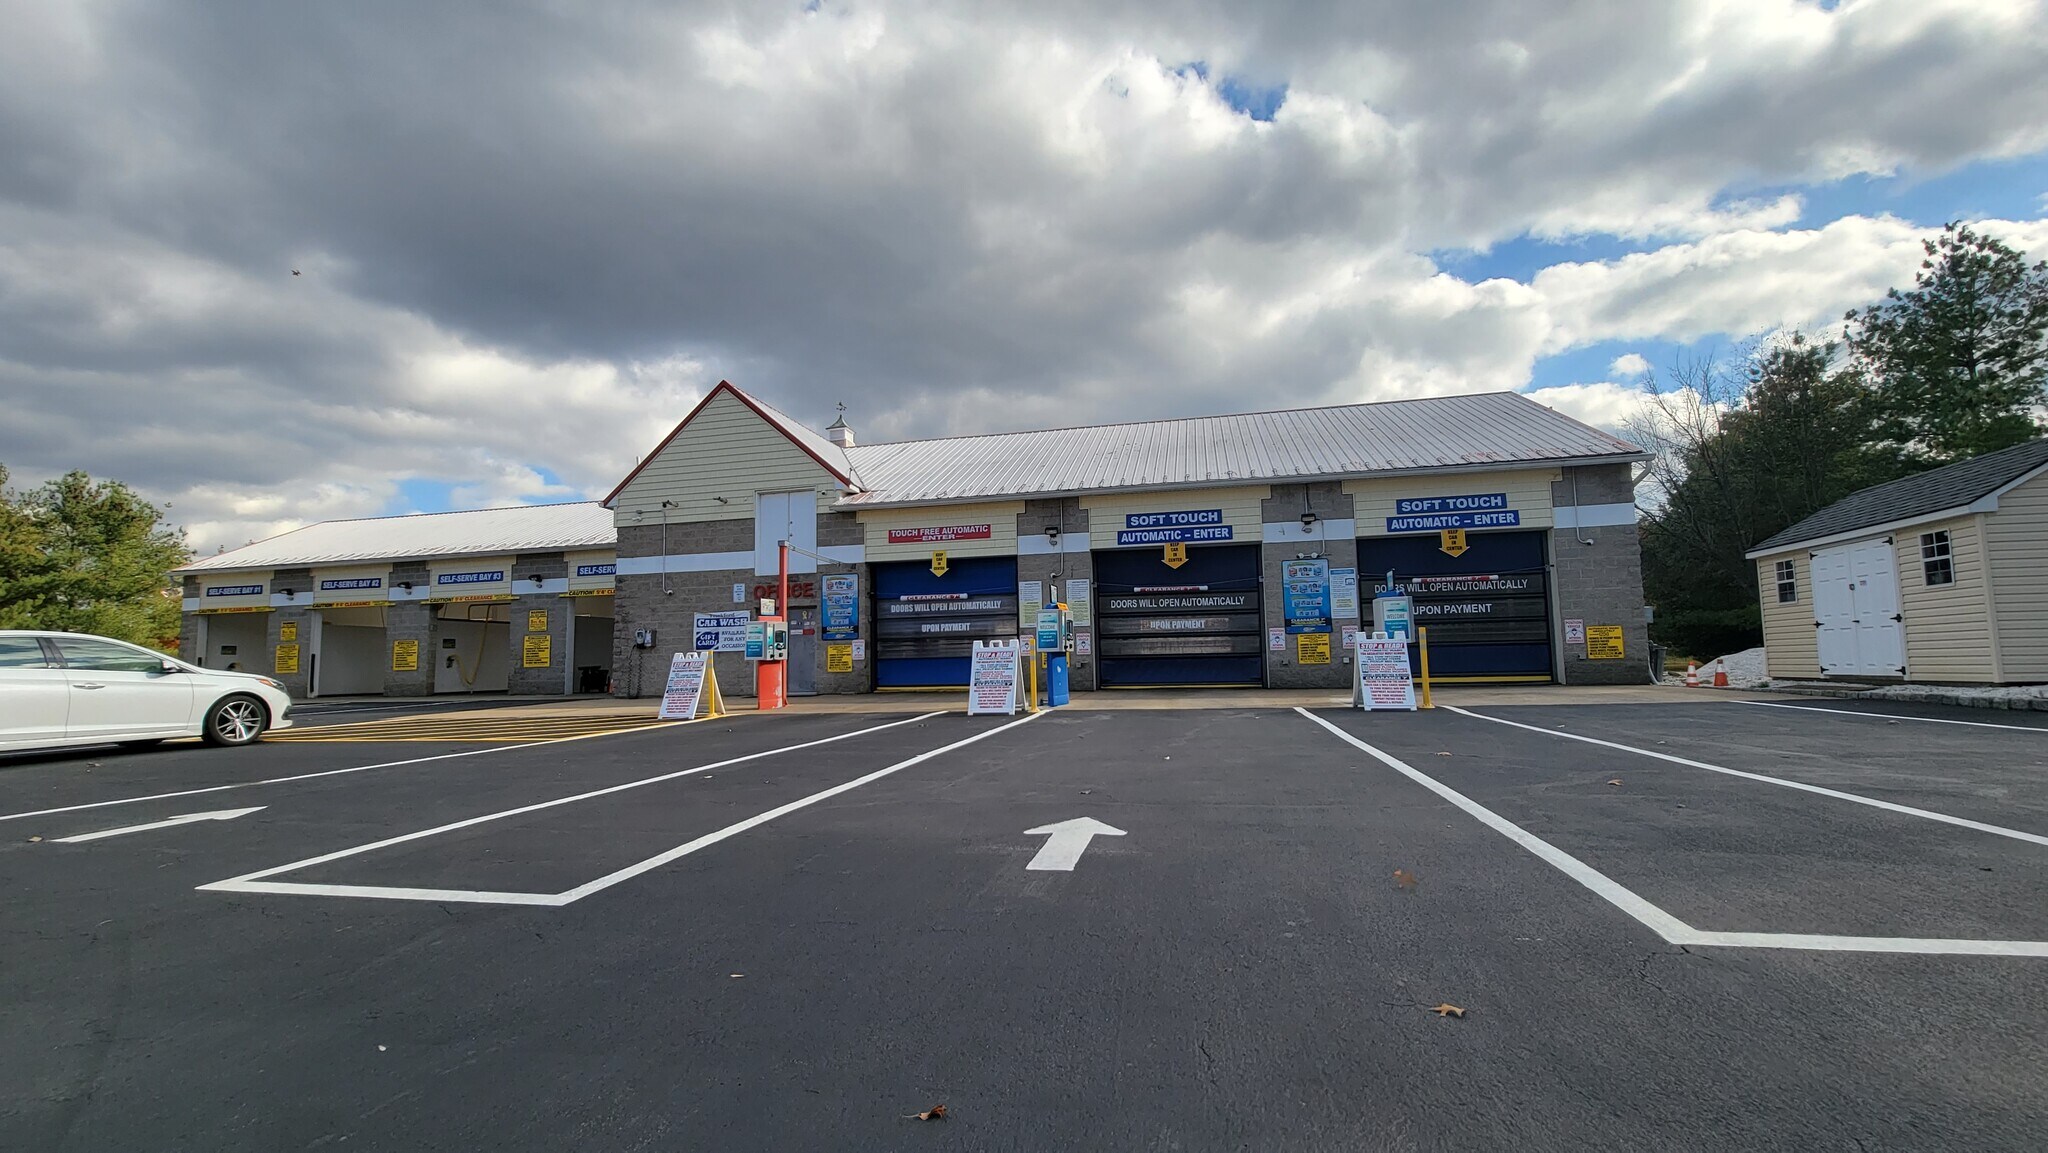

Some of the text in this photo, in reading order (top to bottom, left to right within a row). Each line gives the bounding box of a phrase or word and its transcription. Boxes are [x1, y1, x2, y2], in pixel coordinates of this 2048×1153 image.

[1402, 496, 1501, 511] SOFT TOUCH
[1131, 512, 1218, 526] SOFT TOUCH
[1391, 516, 1460, 529] AUTOMATIC
[1474, 513, 1515, 524] ENTER
[942, 525, 988, 534] AUTOMATIC
[1121, 531, 1181, 542] AUTOMATIC
[1194, 528, 1229, 539] ENTER
[580, 565, 616, 574] SELF-SERV
[440, 572, 501, 583] SELF-SERVE BAY #3
[323, 579, 380, 589] SELF-SERVE BAY #2
[1374, 579, 1528, 593] DORS WILL OPEN AUTOMATICALLY
[208, 587, 242, 596] SELF-SERVE
[253, 586, 261, 594] #1
[891, 600, 1001, 613] DOORS WILL OPEN AUTOMATICALLY
[1111, 596, 1244, 608] DOORS WILL OPEN AUTOMATICALLY
[1413, 606, 1441, 615] UPON
[1444, 604, 1492, 613] PAYMENT
[720, 618, 747, 626] WASH
[922, 623, 971, 632] UPON PAYMENT
[1151, 620, 1205, 629] UPON PAYMENT
